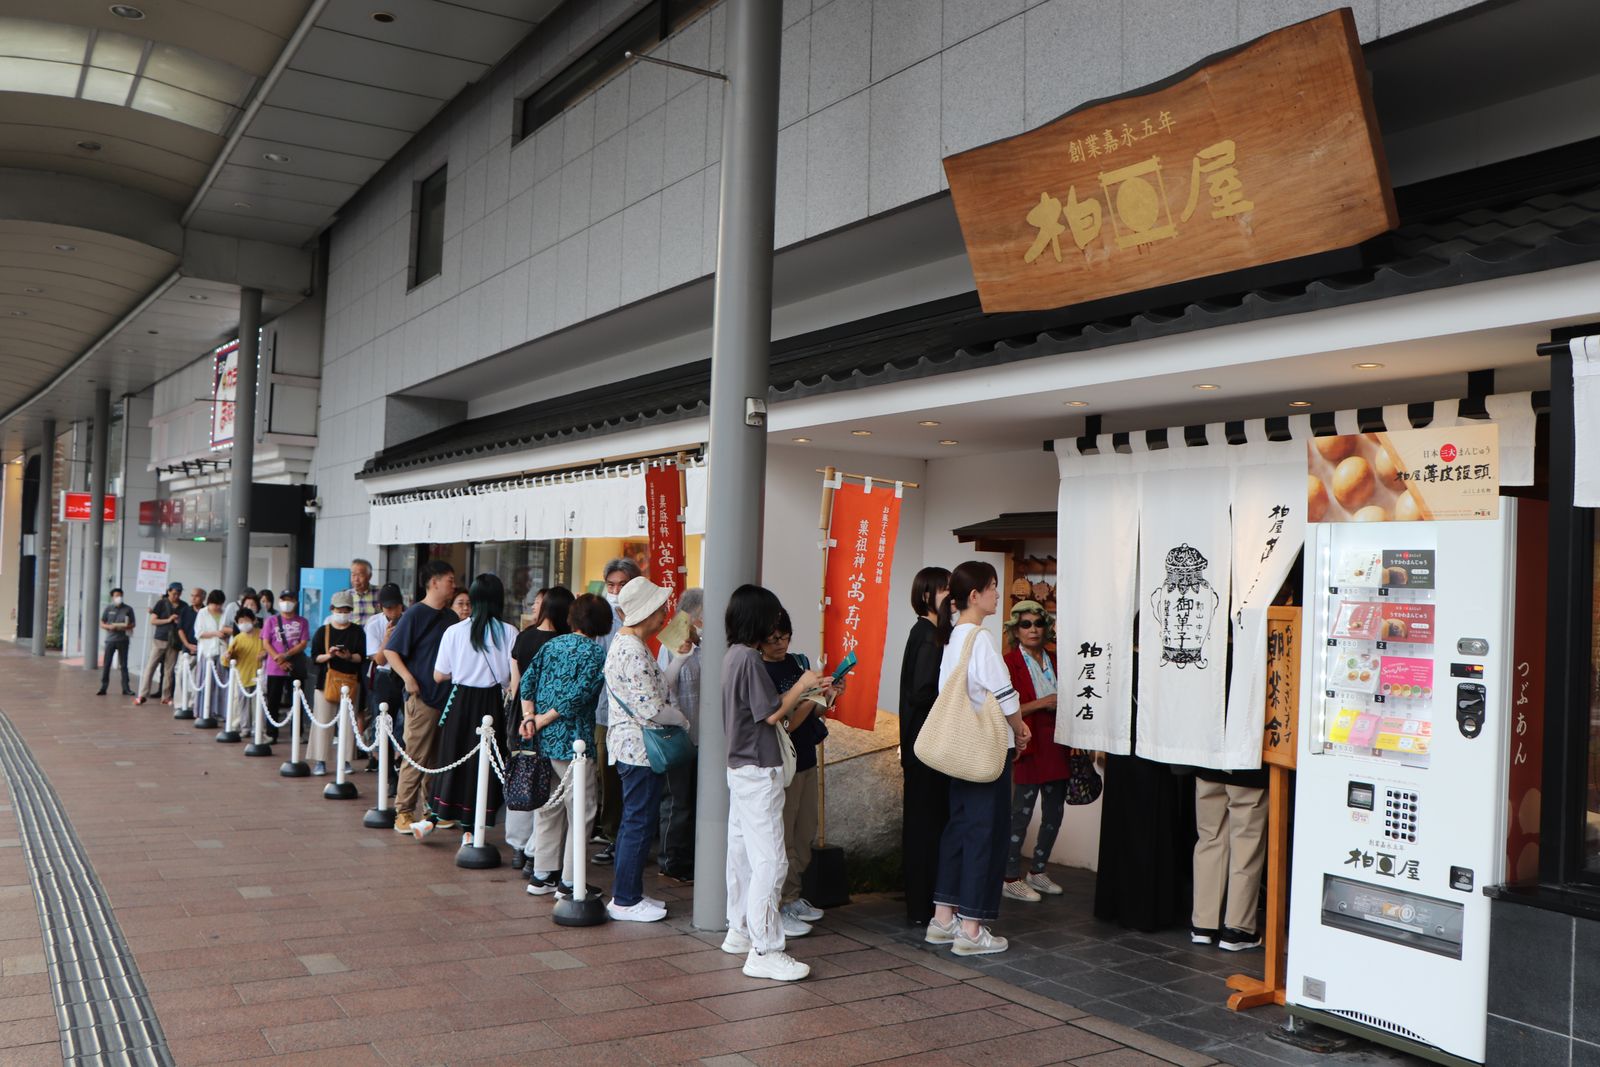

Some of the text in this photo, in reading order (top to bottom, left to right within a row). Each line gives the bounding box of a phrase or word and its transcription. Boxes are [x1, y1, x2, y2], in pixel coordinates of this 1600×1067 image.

[1067, 110, 1177, 165] 創業嘉永五年
[1024, 139, 1255, 264] 柏屋
[1423, 446, 1491, 459] 日本三大まんじゅう
[1173, 596, 1194, 651] 御菓子
[1076, 641, 1102, 721] 柏屋本店
[1514, 662, 1530, 765] つぶあん
